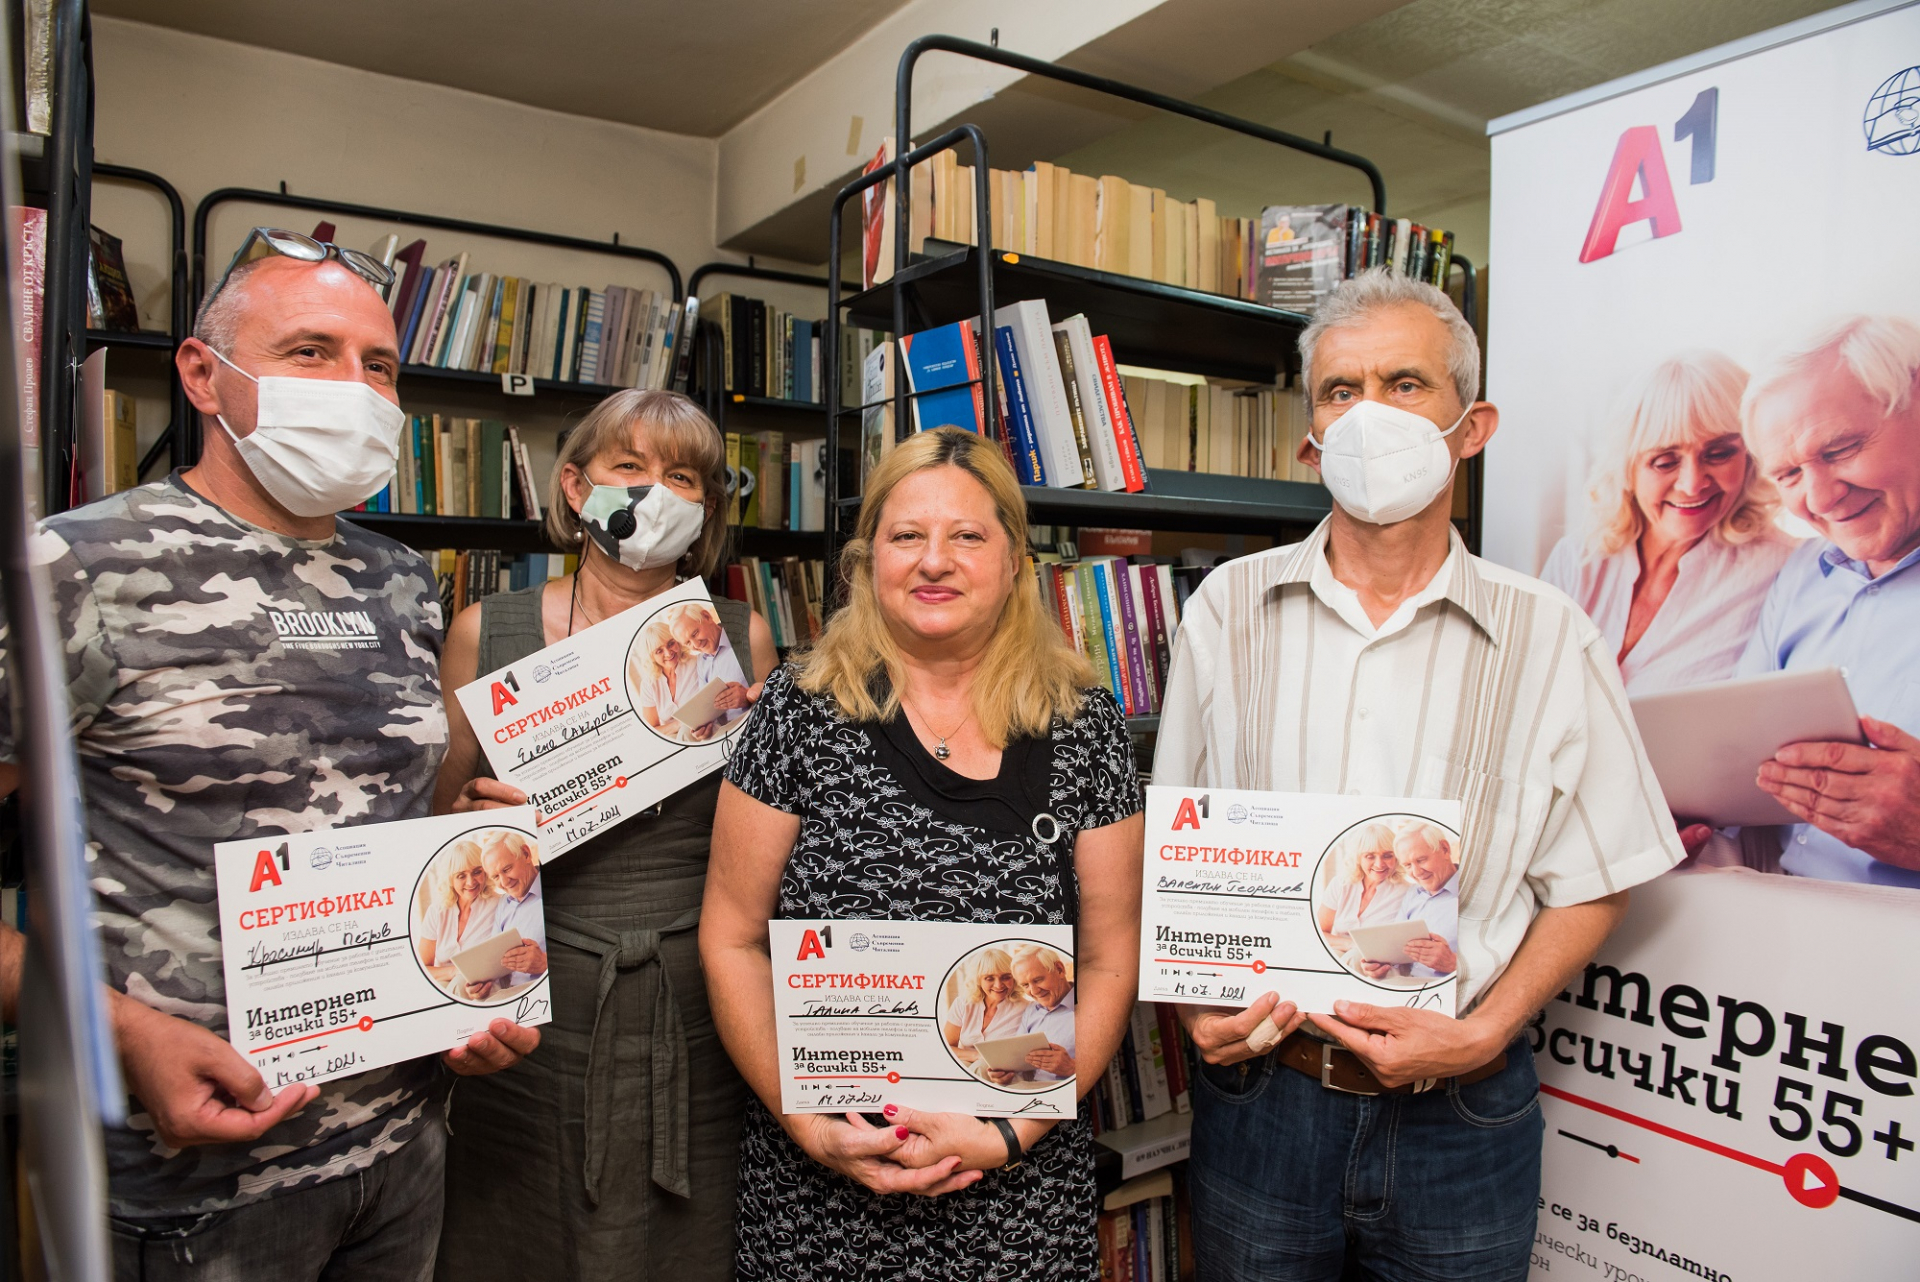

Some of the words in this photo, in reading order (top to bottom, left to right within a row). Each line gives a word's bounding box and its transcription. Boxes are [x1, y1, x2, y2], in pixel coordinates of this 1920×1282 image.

[1578, 86, 1719, 264] A1
[23, 220, 34, 265] КРЪСТА
[23, 268, 34, 285] ОТ
[23, 286, 34, 342] СВАЛЯНЕ
[1028, 449, 1041, 481] Париж
[269, 611, 376, 635] BROOKLYN
[491, 671, 520, 716] A1
[494, 677, 612, 744] СЕРТИФИКАТ
[533, 723, 564, 742] ИЗДАВА
[566, 716, 577, 726] СЕ
[578, 710, 590, 721] НА
[527, 755, 623, 807] Интернет
[544, 788, 590, 815] всички
[590, 775, 612, 791] 55+
[1171, 794, 1210, 831] A1
[249, 842, 290, 892] A1
[1159, 844, 1302, 868] СЕРТИФИКАТ
[1195, 869, 1234, 880] ИЗДАВА
[1236, 872, 1248, 880] СЕ
[1250, 873, 1264, 881] НА
[239, 887, 395, 930] СЕРТИФИКАТ
[282, 926, 326, 942] ИЗДАВА
[328, 922, 341, 932] СЕ
[343, 920, 358, 930] НА
[796, 925, 832, 961] A1
[1155, 925, 1272, 949] Интернет
[1156, 942, 1168, 952] за
[1169, 943, 1222, 959] всички
[1226, 946, 1253, 960] 55+
[787, 973, 925, 990] СЕРТИФИКАТ
[246, 987, 376, 1029] Интернет
[825, 995, 861, 1003] ИЗДАВА
[864, 995, 875, 1003] СЕ
[877, 995, 891, 1003] НА
[249, 1029, 262, 1041] за
[264, 1015, 324, 1041] всички
[329, 1008, 358, 1026] 55+
[1556, 962, 1918, 1097] терне
[792, 1047, 904, 1063] Интернет
[794, 1062, 804, 1071] за
[807, 1062, 858, 1074] всички
[862, 1062, 887, 1073] 55+
[1769, 1076, 1915, 1162] 55+
[1551, 1203, 1572, 1220] се
[1577, 1213, 1600, 1233] за
[1534, 1231, 1598, 1269] ически
